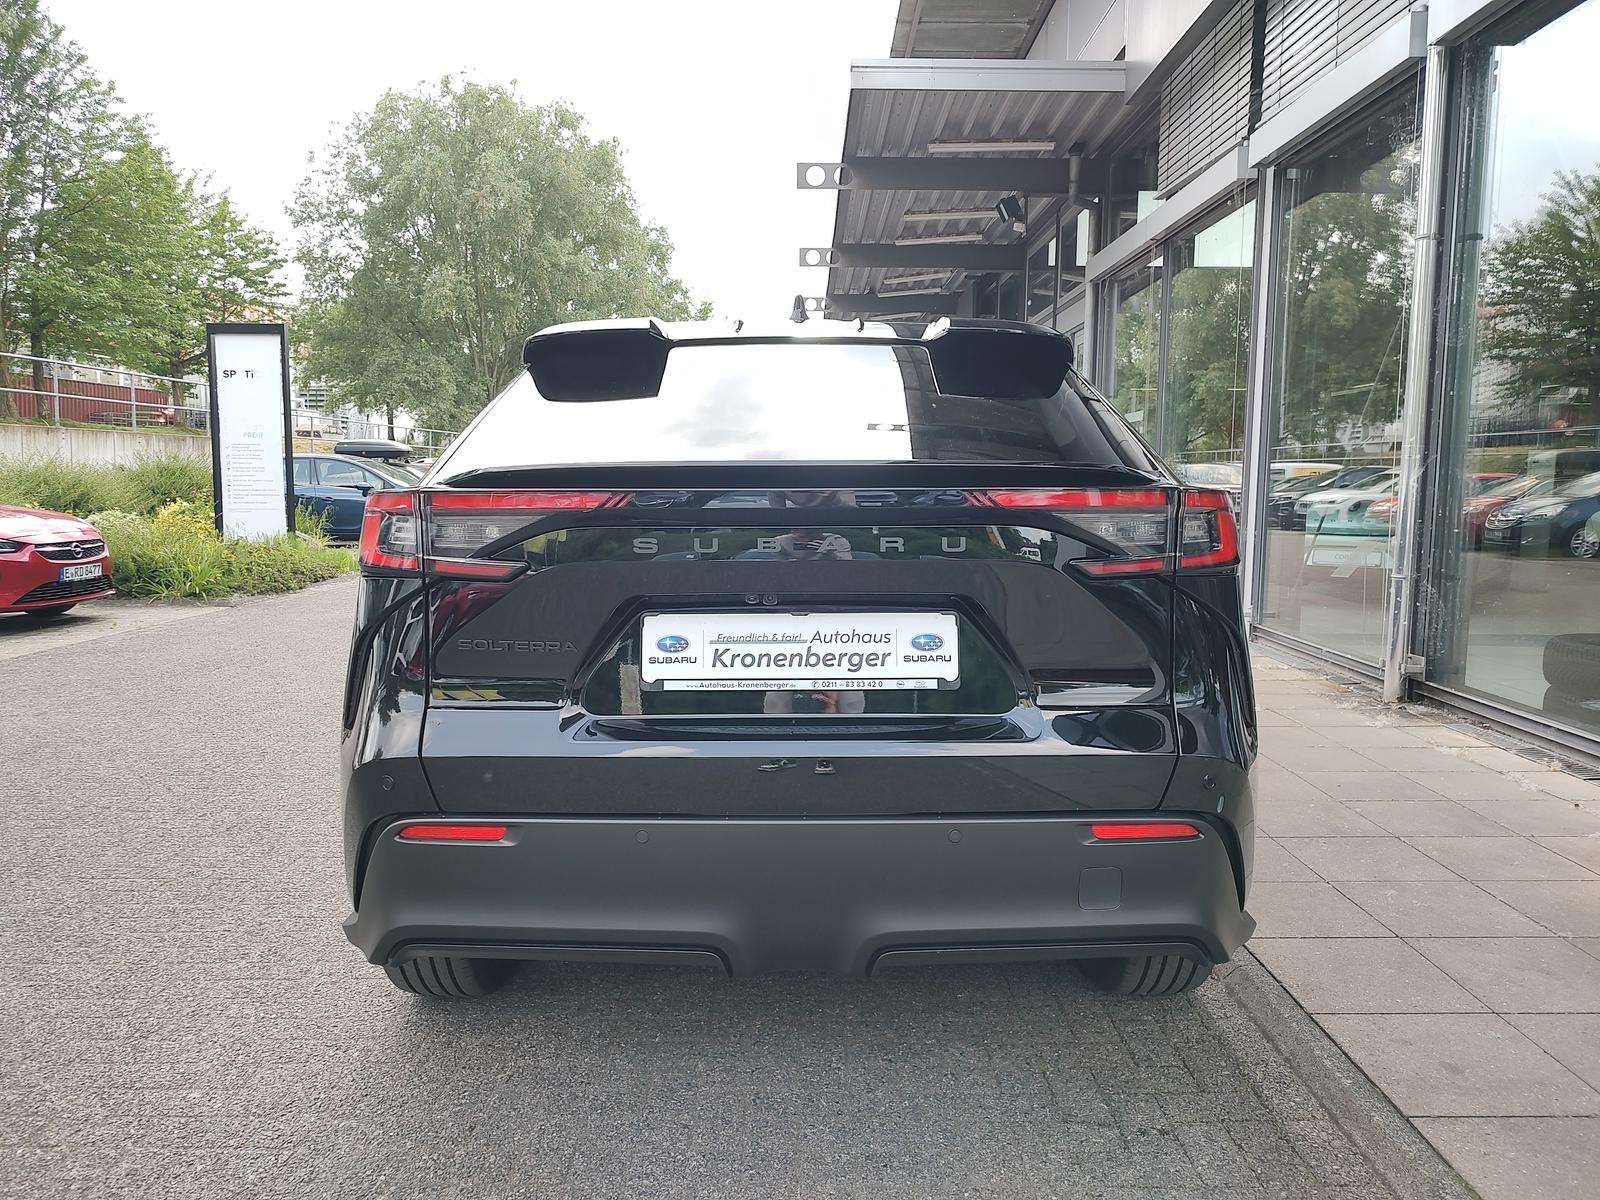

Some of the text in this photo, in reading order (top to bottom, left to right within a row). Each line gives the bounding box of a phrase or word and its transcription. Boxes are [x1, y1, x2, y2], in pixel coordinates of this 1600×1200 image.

[632, 536, 968, 555] SUBARU
[716, 628, 892, 644] Freundlich & fair! Autohaus
[457, 639, 579, 653] SOLTERRA
[648, 656, 697, 665] SUBARU
[711, 645, 892, 673] Kronenberger
[903, 654, 952, 663] SUBARU
